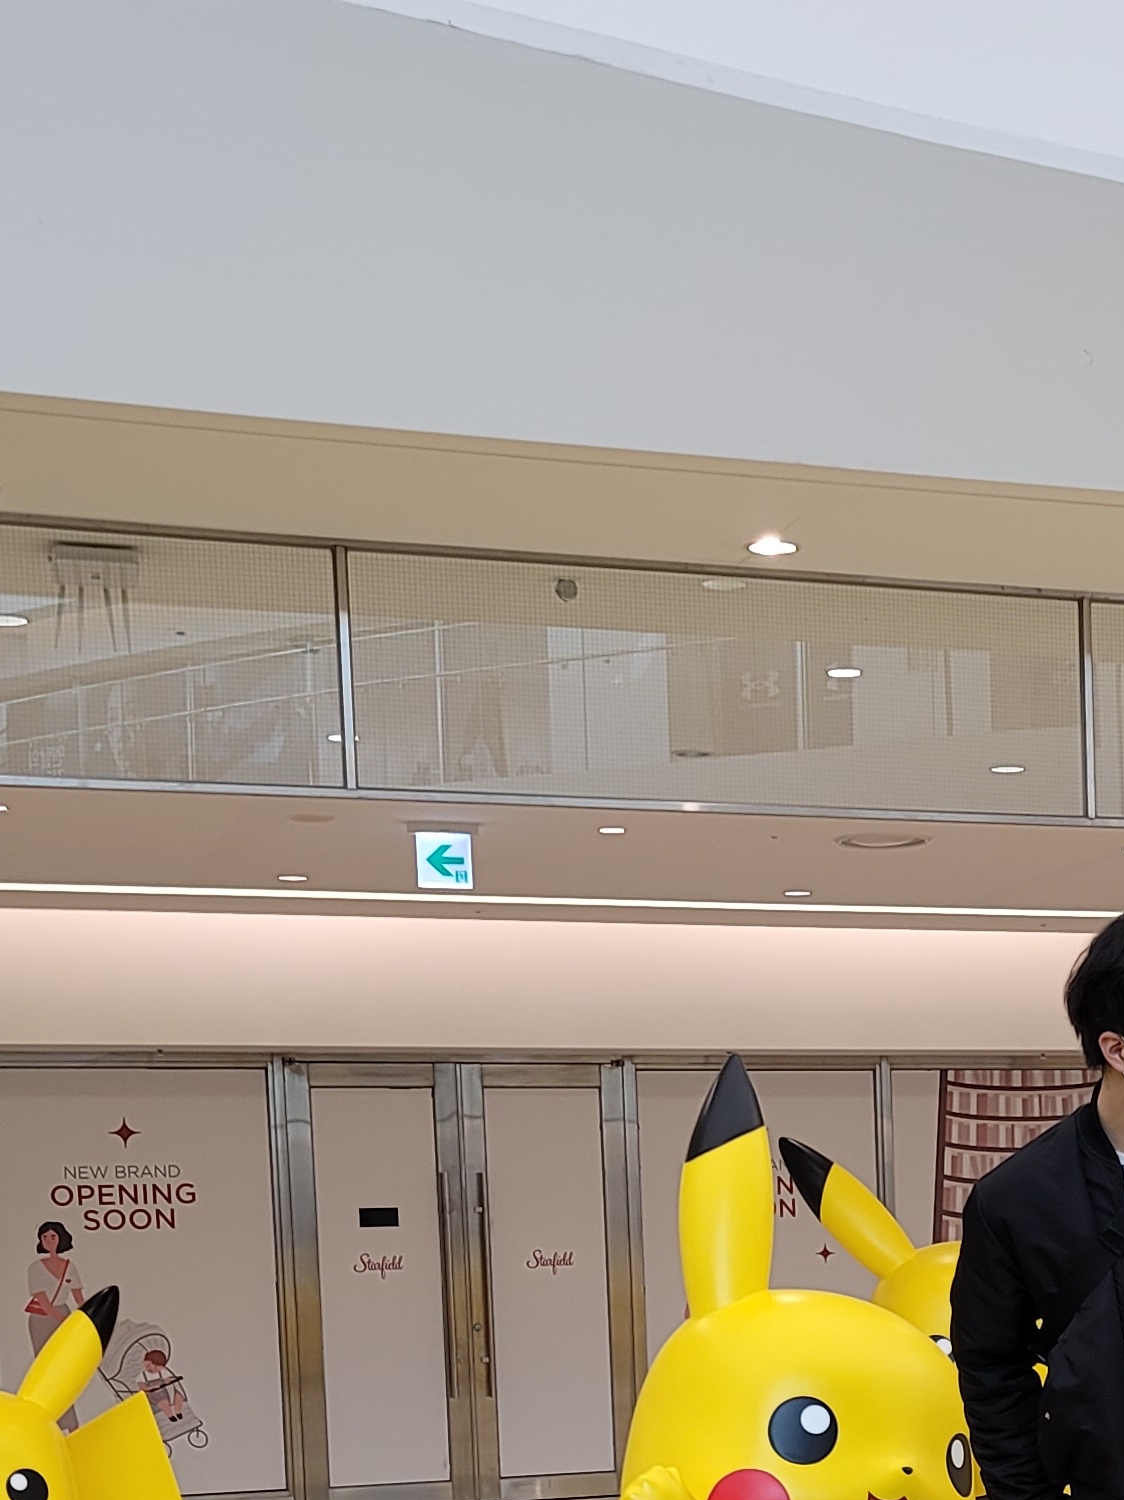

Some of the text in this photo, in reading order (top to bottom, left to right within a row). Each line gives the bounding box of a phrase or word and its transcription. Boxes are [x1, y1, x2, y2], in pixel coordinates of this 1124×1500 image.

[64, 1164, 181, 1179] NEW BRAND
[50, 1183, 197, 1207] OPENING
[83, 1208, 176, 1231] SOON
[353, 1253, 403, 1279] Starfield
[526, 1249, 574, 1275] Starfield
